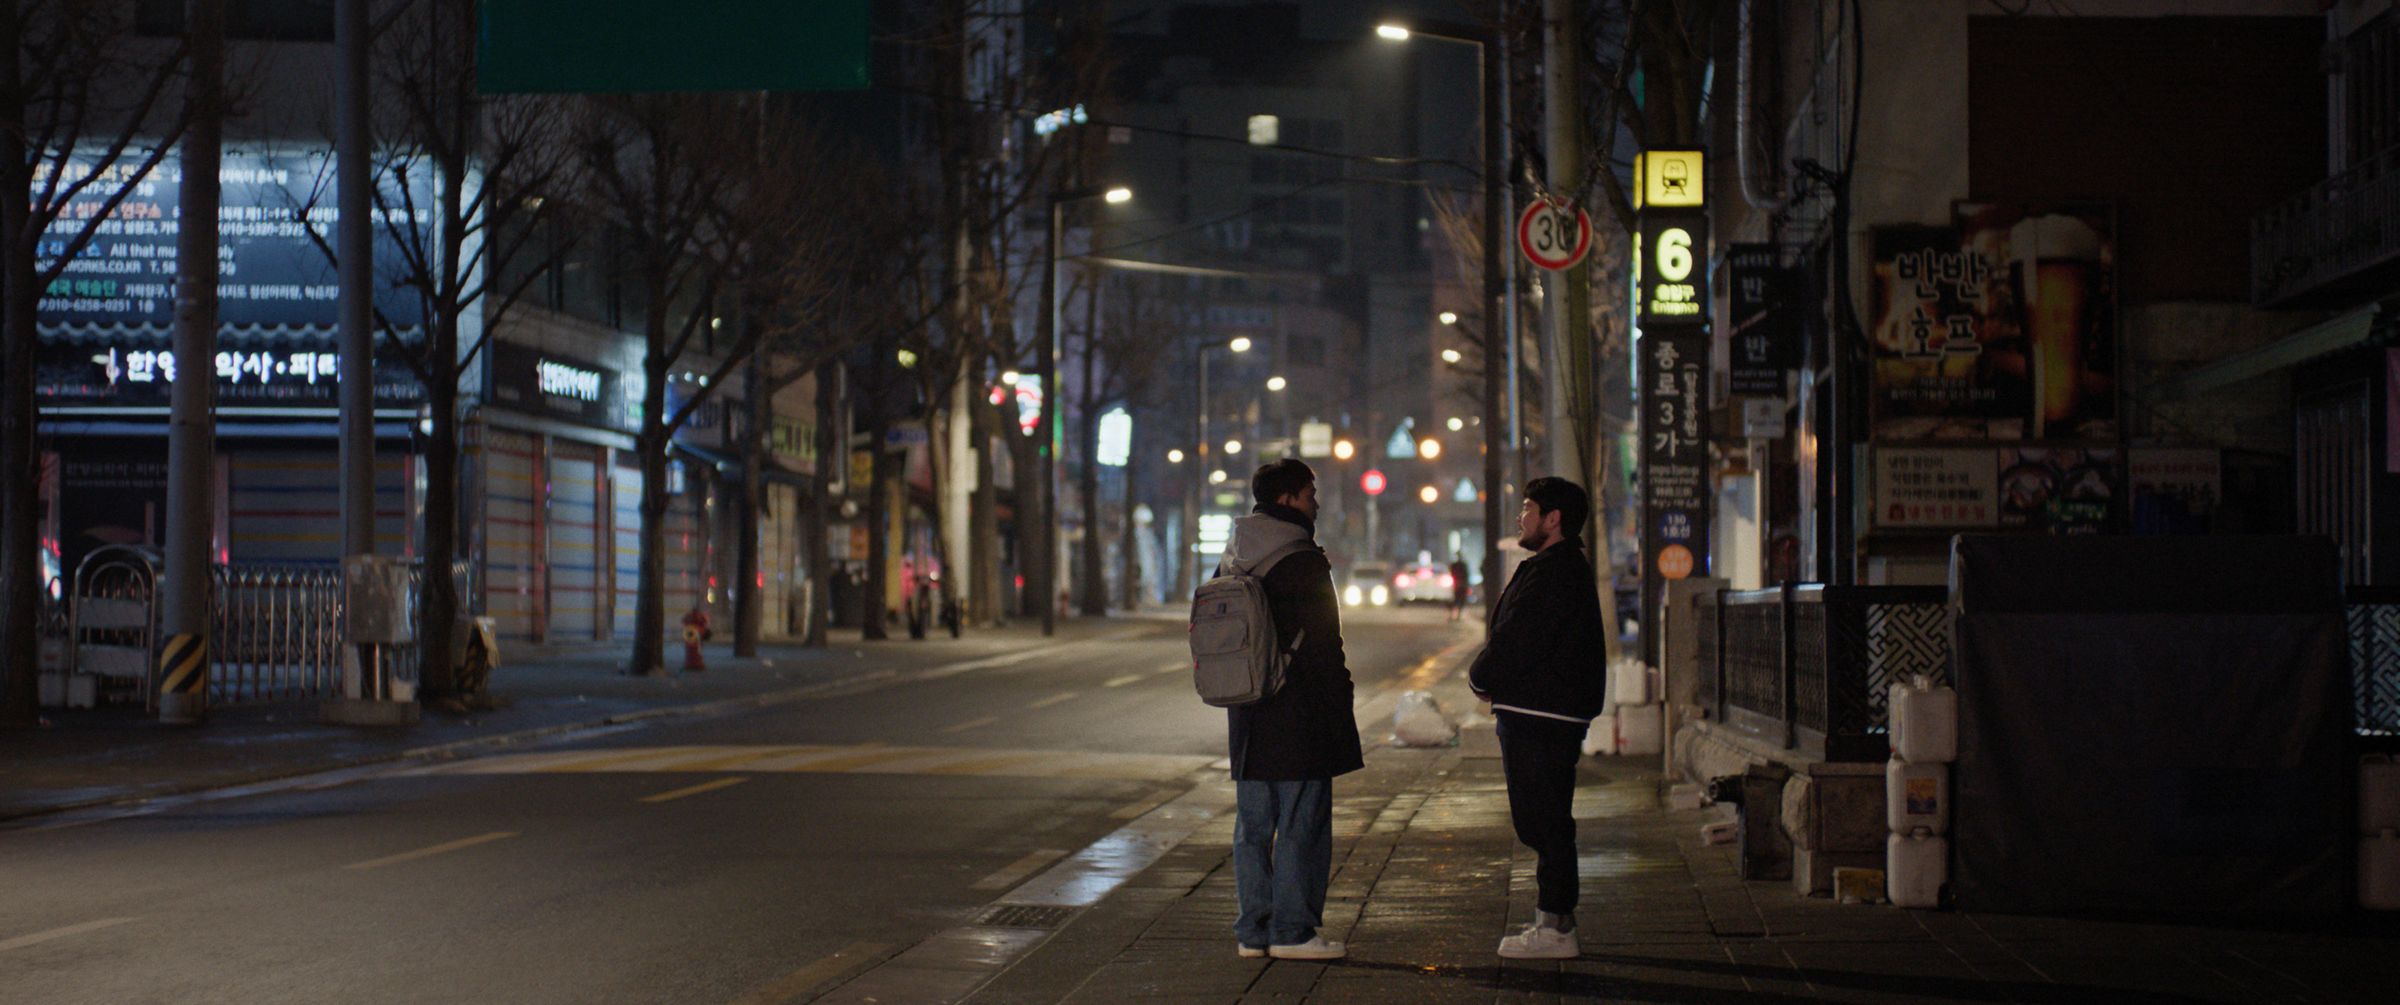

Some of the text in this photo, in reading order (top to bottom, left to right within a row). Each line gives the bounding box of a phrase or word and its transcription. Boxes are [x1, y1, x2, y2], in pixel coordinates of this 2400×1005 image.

[110, 243, 127, 257] All
[130, 243, 155, 257] that
[157, 245, 177, 257] mu
[1656, 227, 1693, 282] 6
[1896, 247, 1987, 301] 반반
[1903, 304, 1983, 360] 호프
[1654, 341, 1680, 458] 종로3가
